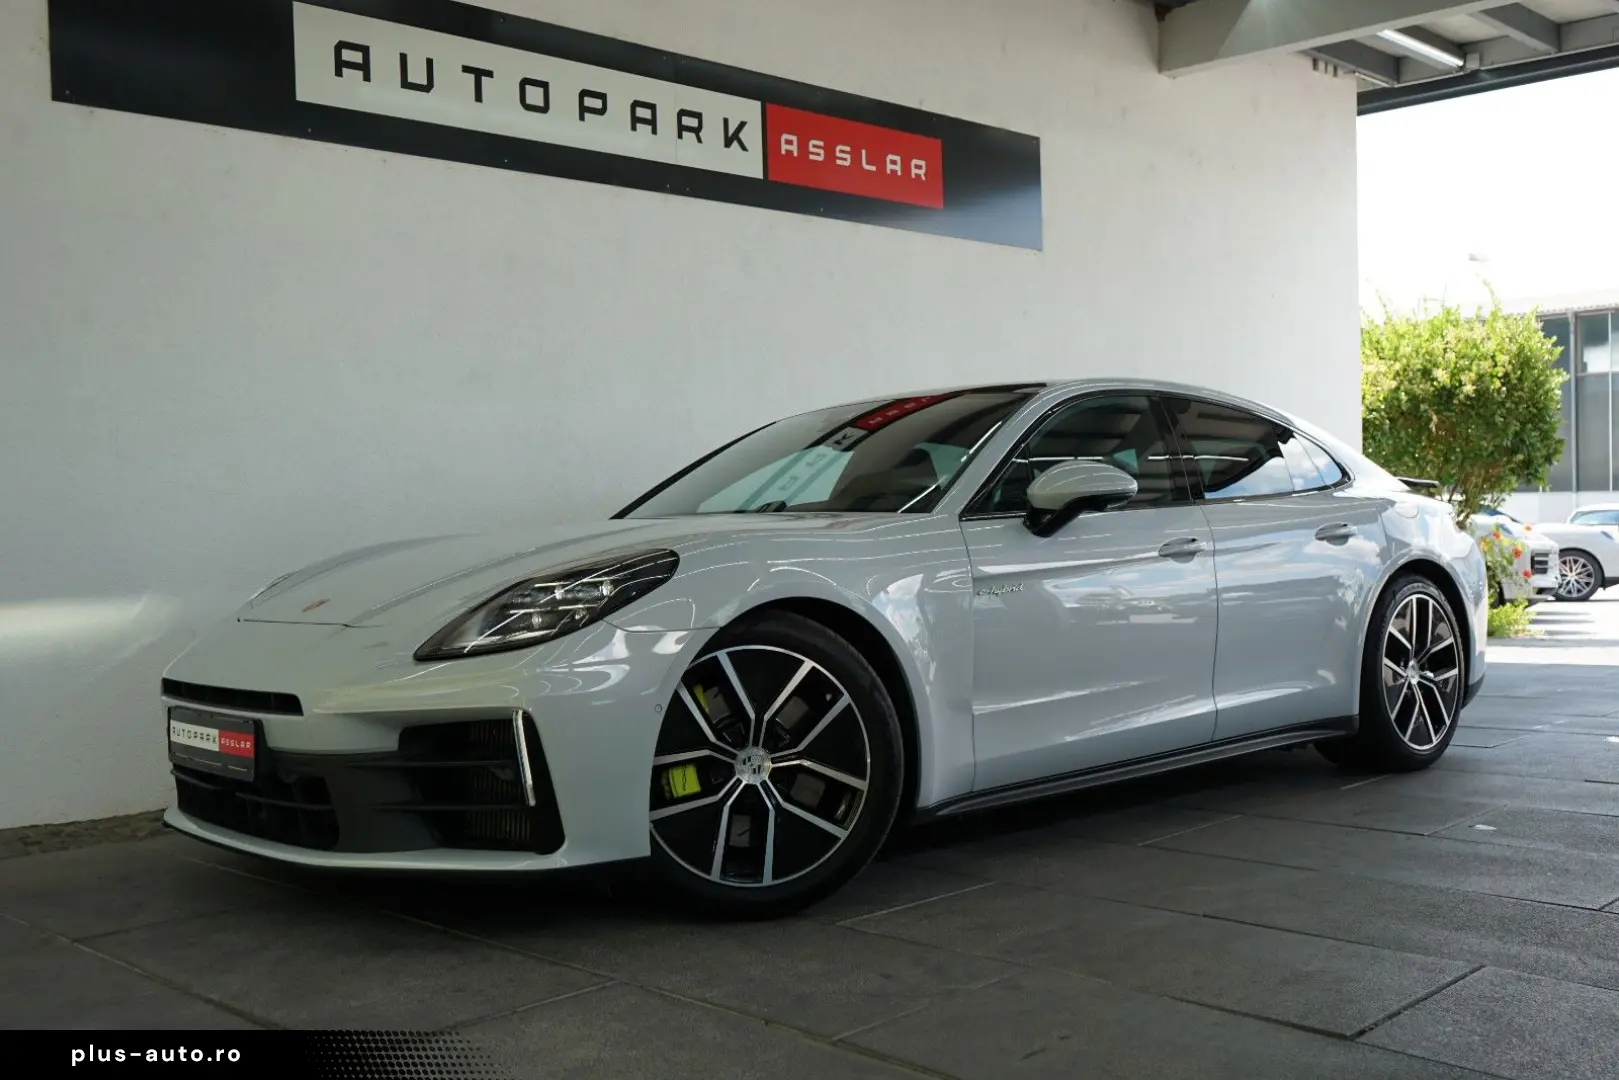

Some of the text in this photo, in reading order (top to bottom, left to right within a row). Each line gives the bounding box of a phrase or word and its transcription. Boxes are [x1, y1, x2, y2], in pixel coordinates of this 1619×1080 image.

[334, 39, 927, 181] AUTOPARK ASSLAR
[172, 726, 252, 749] AUTOPARK ASSLAR
